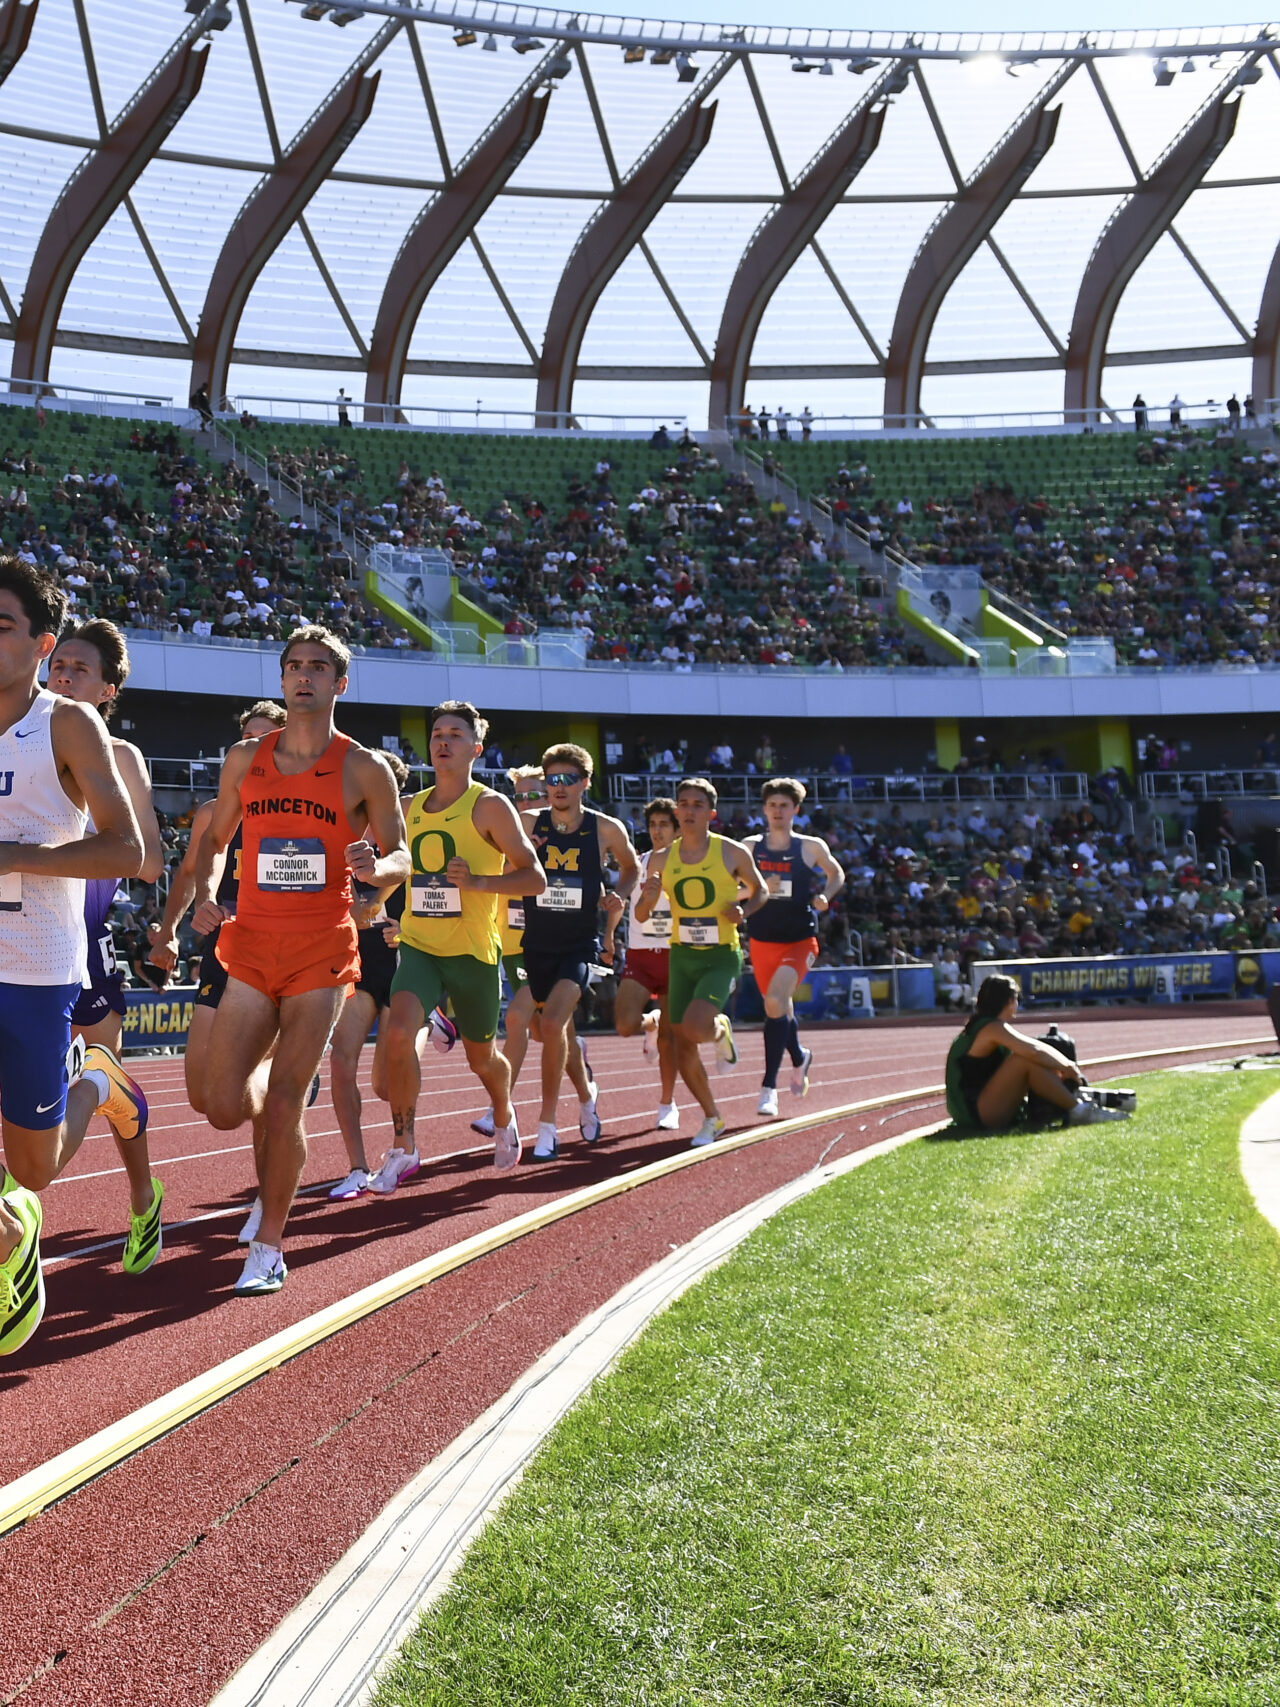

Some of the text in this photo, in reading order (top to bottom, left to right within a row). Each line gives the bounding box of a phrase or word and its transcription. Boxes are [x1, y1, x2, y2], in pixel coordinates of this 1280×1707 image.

[246, 797, 336, 826] PRINCETON
[411, 830, 456, 874] O
[545, 845, 580, 871] M
[273, 859, 308, 869] CONNOR
[265, 871, 317, 881] MCCORMICK
[424, 891, 445, 900] TOMAS
[550, 890, 567, 898] TRENT
[674, 876, 715, 910] O
[422, 901, 448, 910] PALFREY
[1030, 968, 1128, 993] CHAMPIONS
[852, 990, 863, 1007] 9
[123, 1001, 195, 1034] #NCAA
